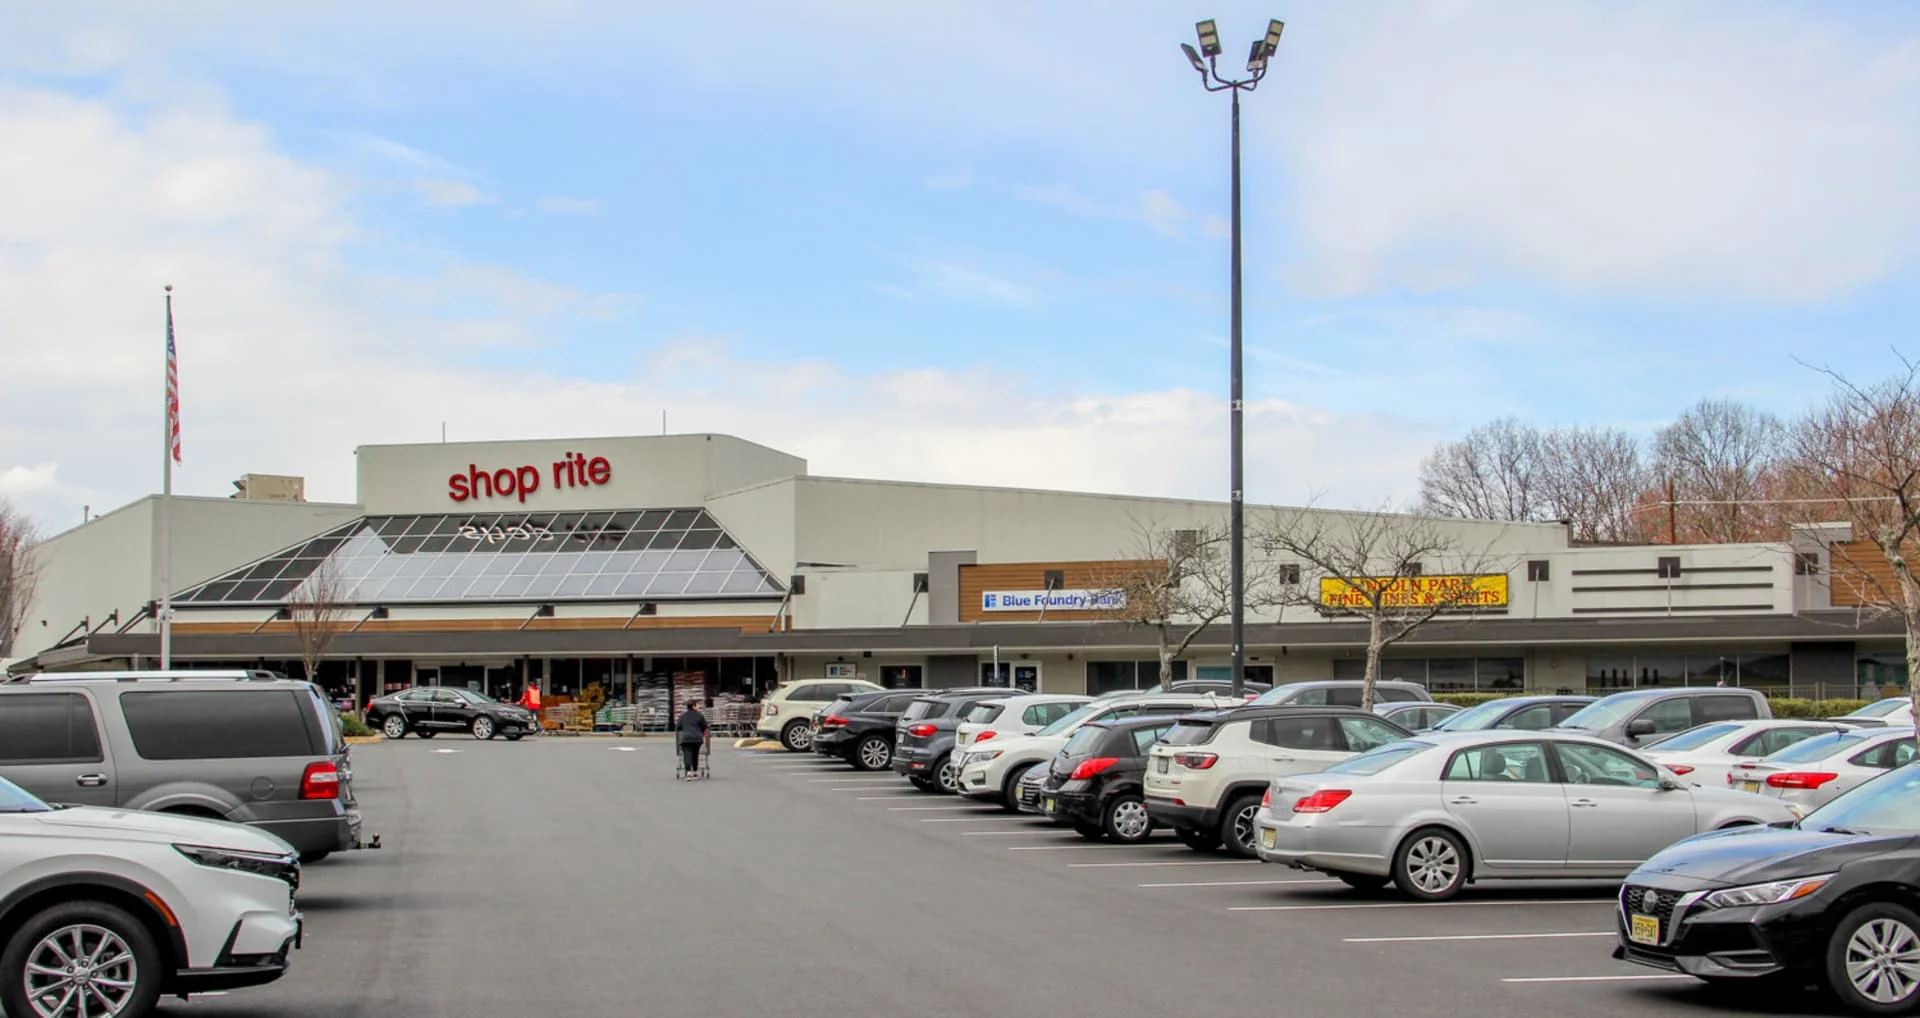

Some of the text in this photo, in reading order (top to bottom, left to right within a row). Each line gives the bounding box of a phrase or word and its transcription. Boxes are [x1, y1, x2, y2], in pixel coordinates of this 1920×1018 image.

[449, 452, 612, 503] shop rite
[1002, 594, 1032, 606] Blue
[1034, 593, 1086, 608] Foundry
[1328, 593, 1364, 606] FINE
